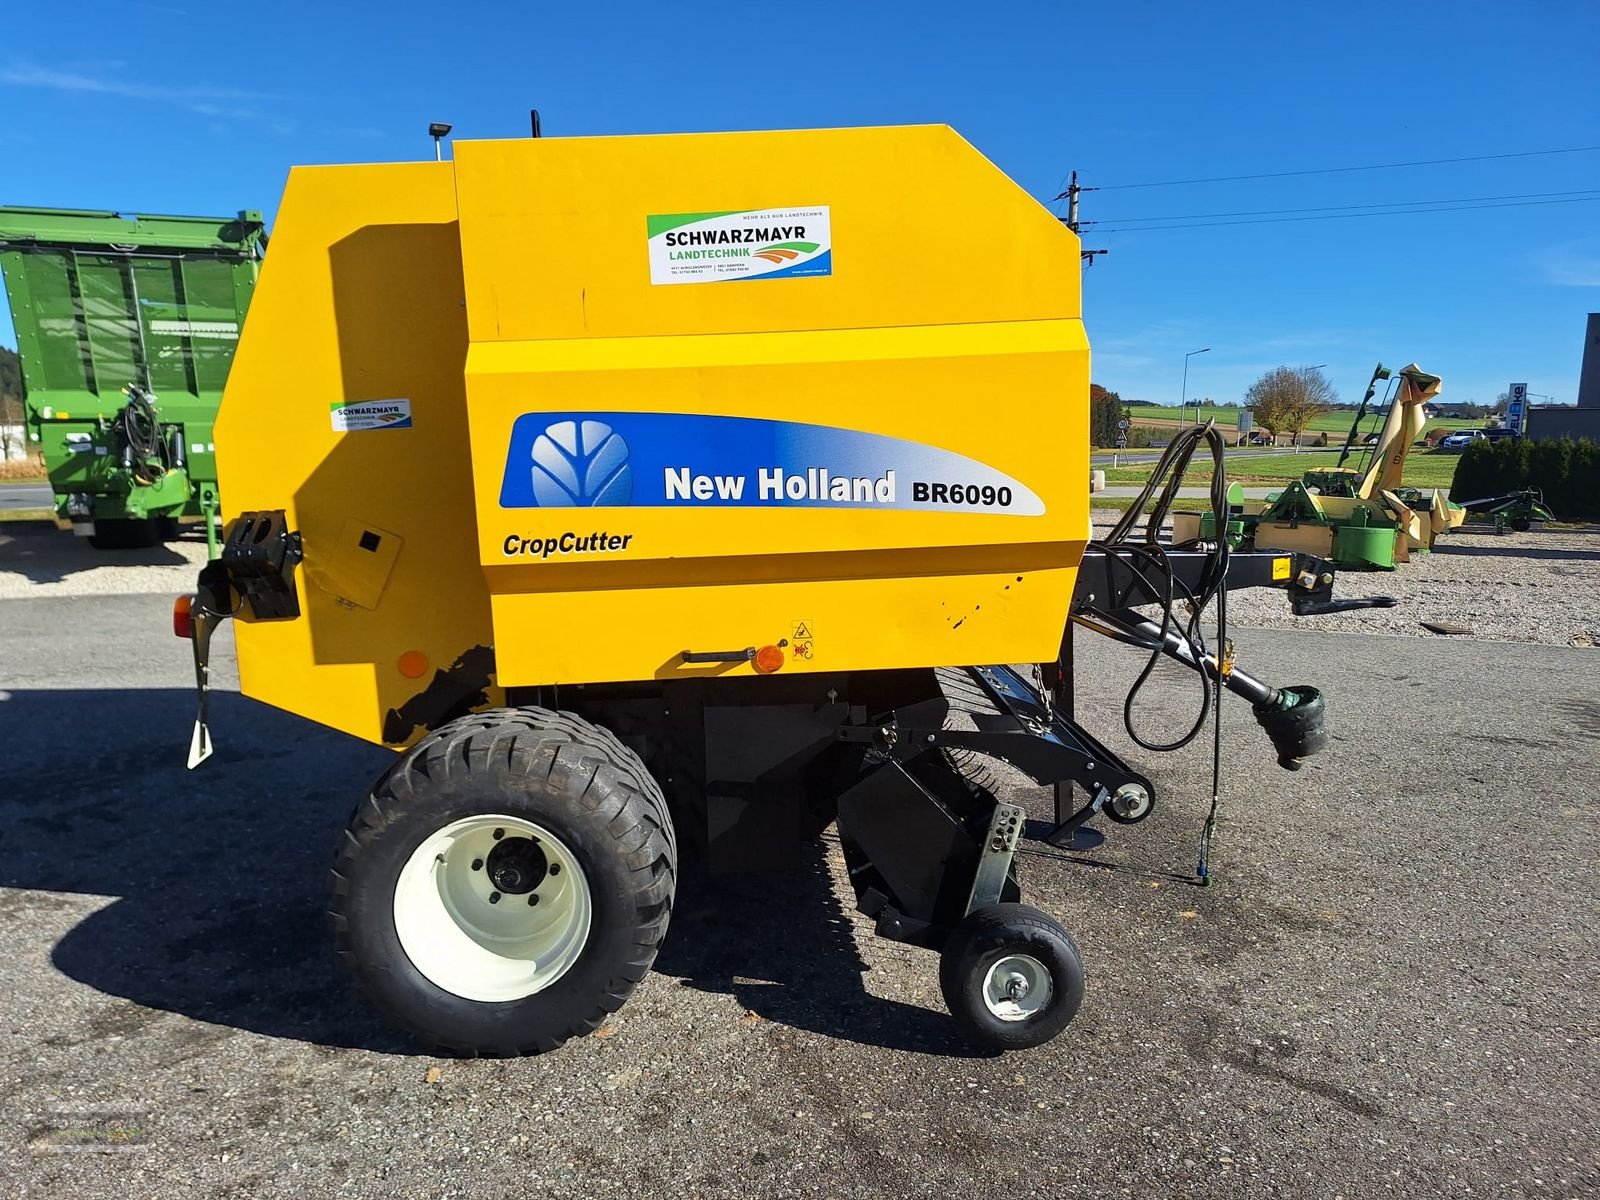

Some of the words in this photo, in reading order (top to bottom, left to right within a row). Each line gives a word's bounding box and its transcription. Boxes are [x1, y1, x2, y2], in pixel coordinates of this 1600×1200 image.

[666, 226, 806, 247] SCHWARZMAYR
[669, 247, 750, 261] LANDTECHNIK
[338, 406, 399, 416] SCHWARZMAYR
[664, 467, 745, 500] New
[758, 468, 896, 503] Holland
[912, 482, 1012, 507] BR6090
[502, 532, 633, 557] CropCutter
